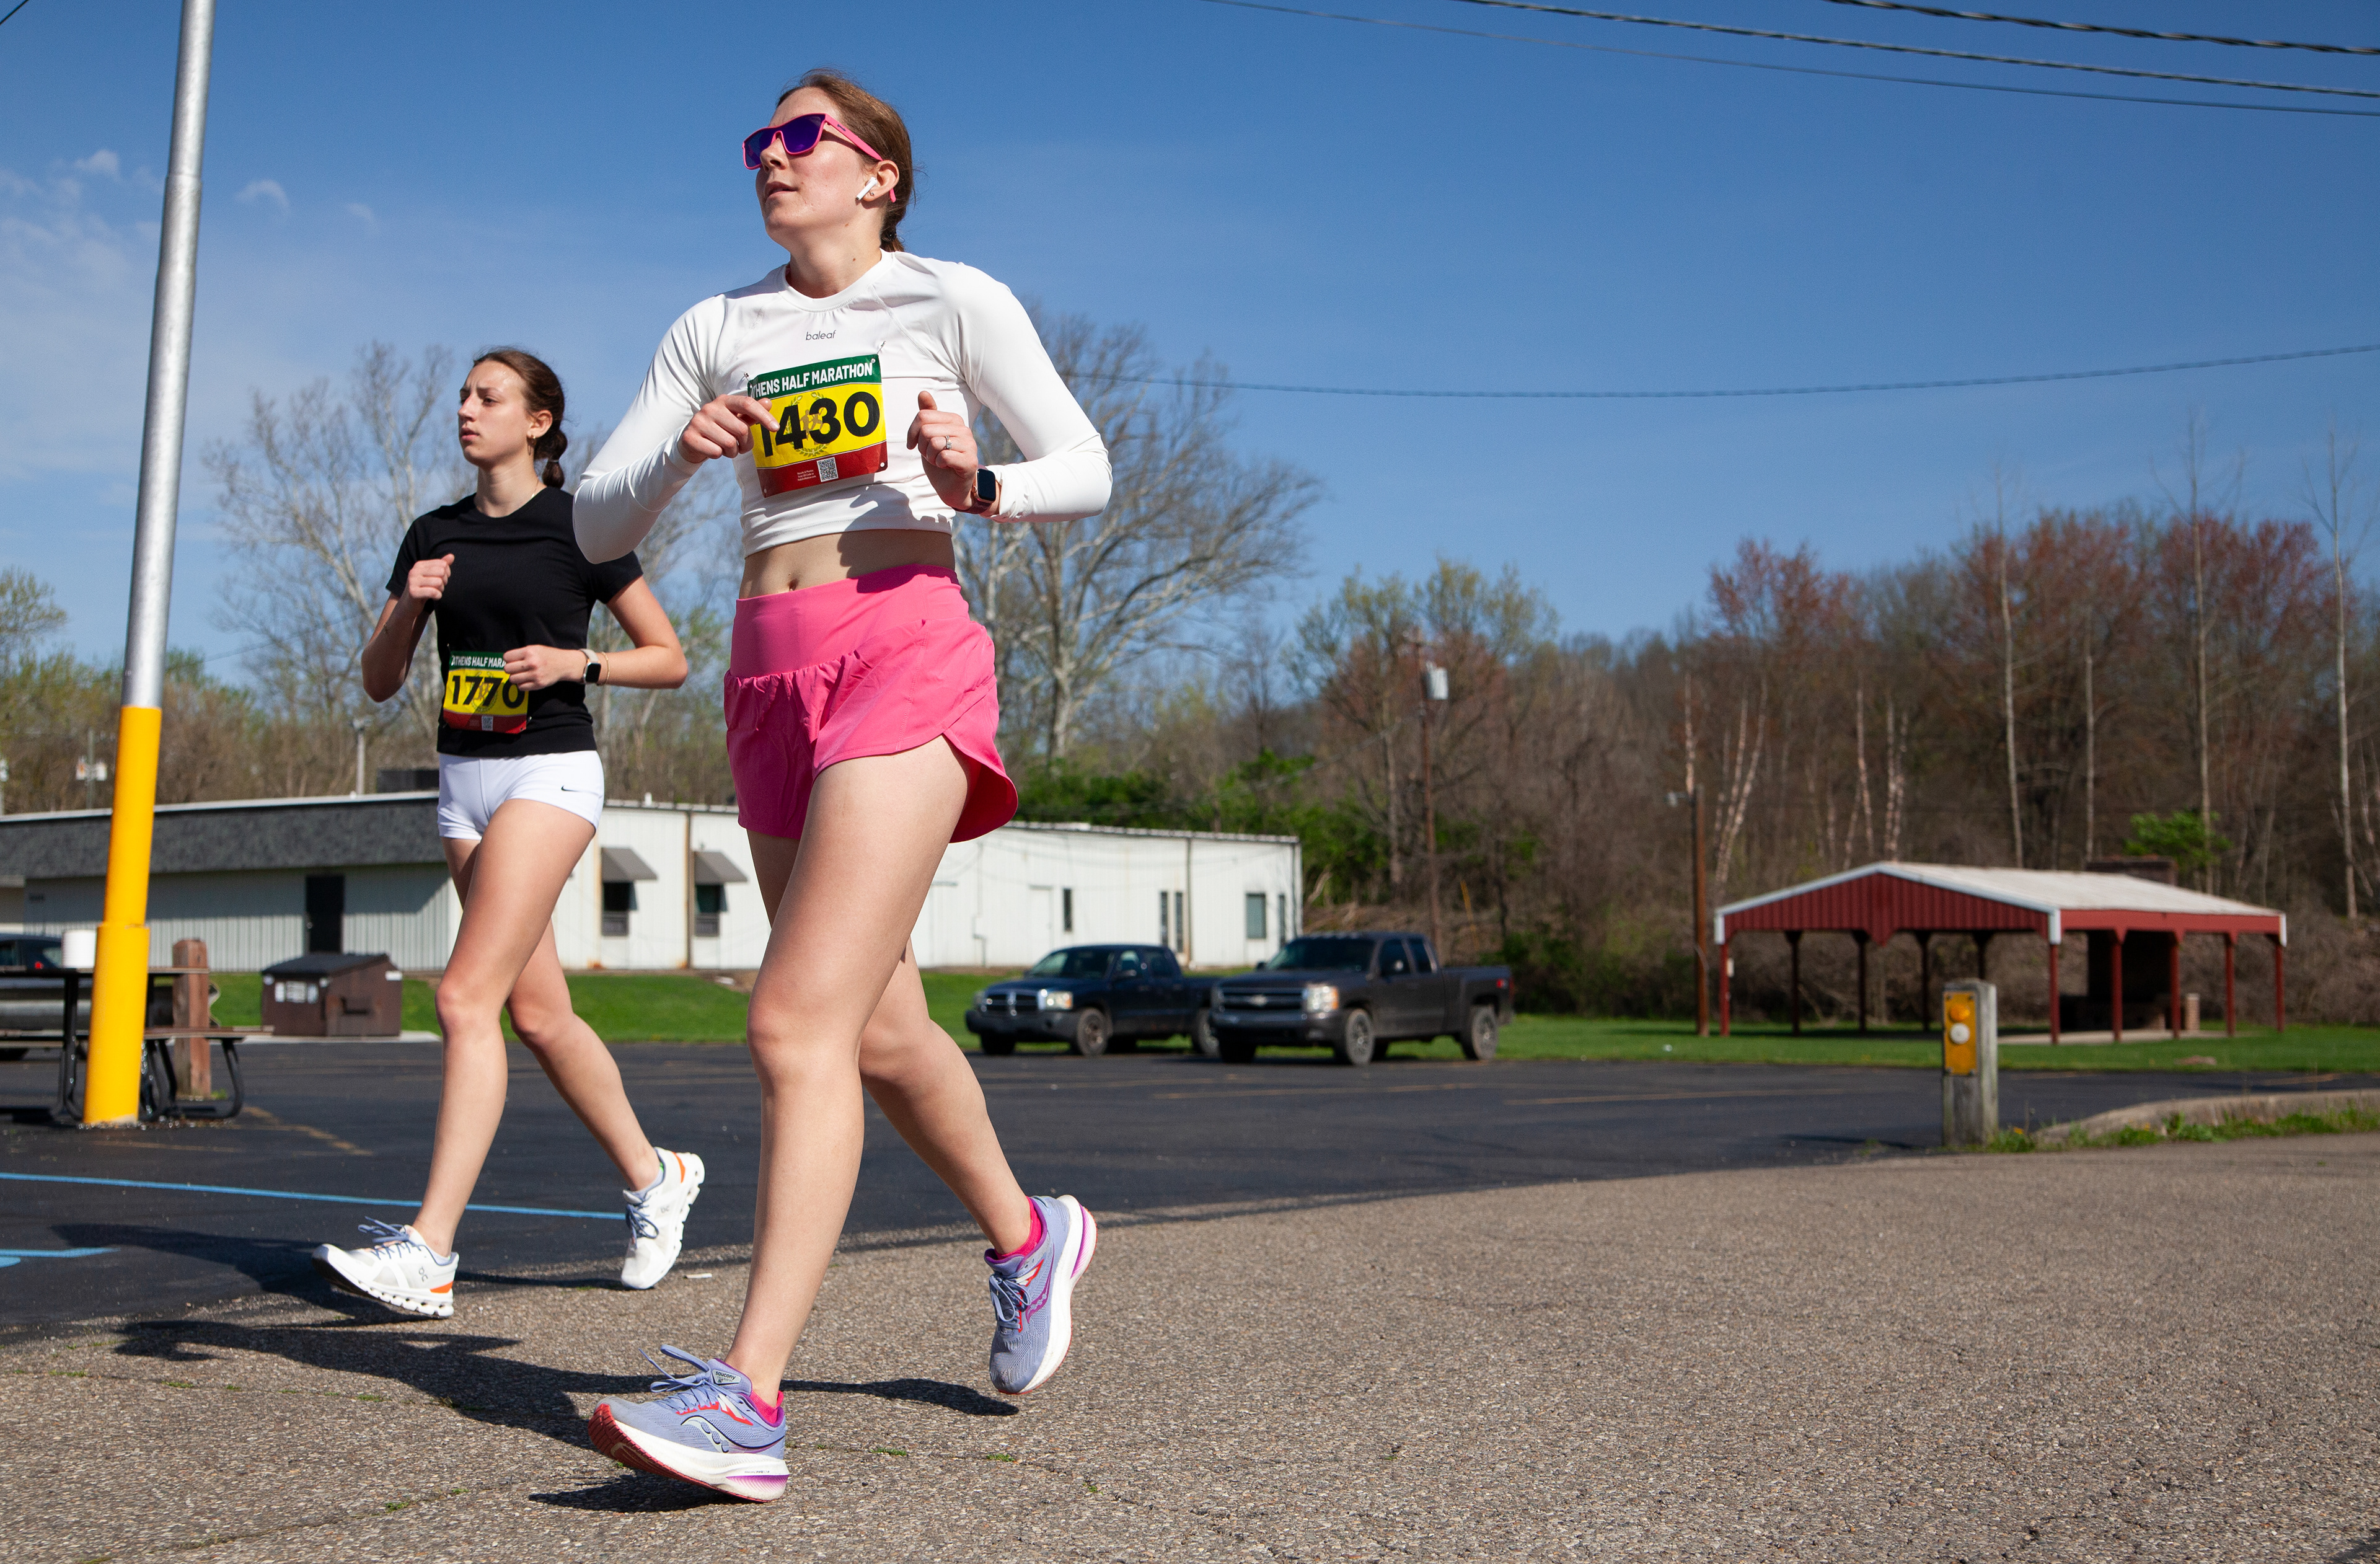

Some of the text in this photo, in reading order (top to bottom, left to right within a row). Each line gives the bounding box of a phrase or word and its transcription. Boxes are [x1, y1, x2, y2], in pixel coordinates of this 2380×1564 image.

[806, 329, 836, 340] baleaf
[782, 372, 810, 392] HALF
[812, 363, 873, 385] MARATHON
[756, 391, 880, 457] 1430
[451, 655, 472, 666] ATHENS
[472, 656, 488, 667] HALF
[452, 675, 526, 709] 1770
[716, 1371, 736, 1380] saucony
